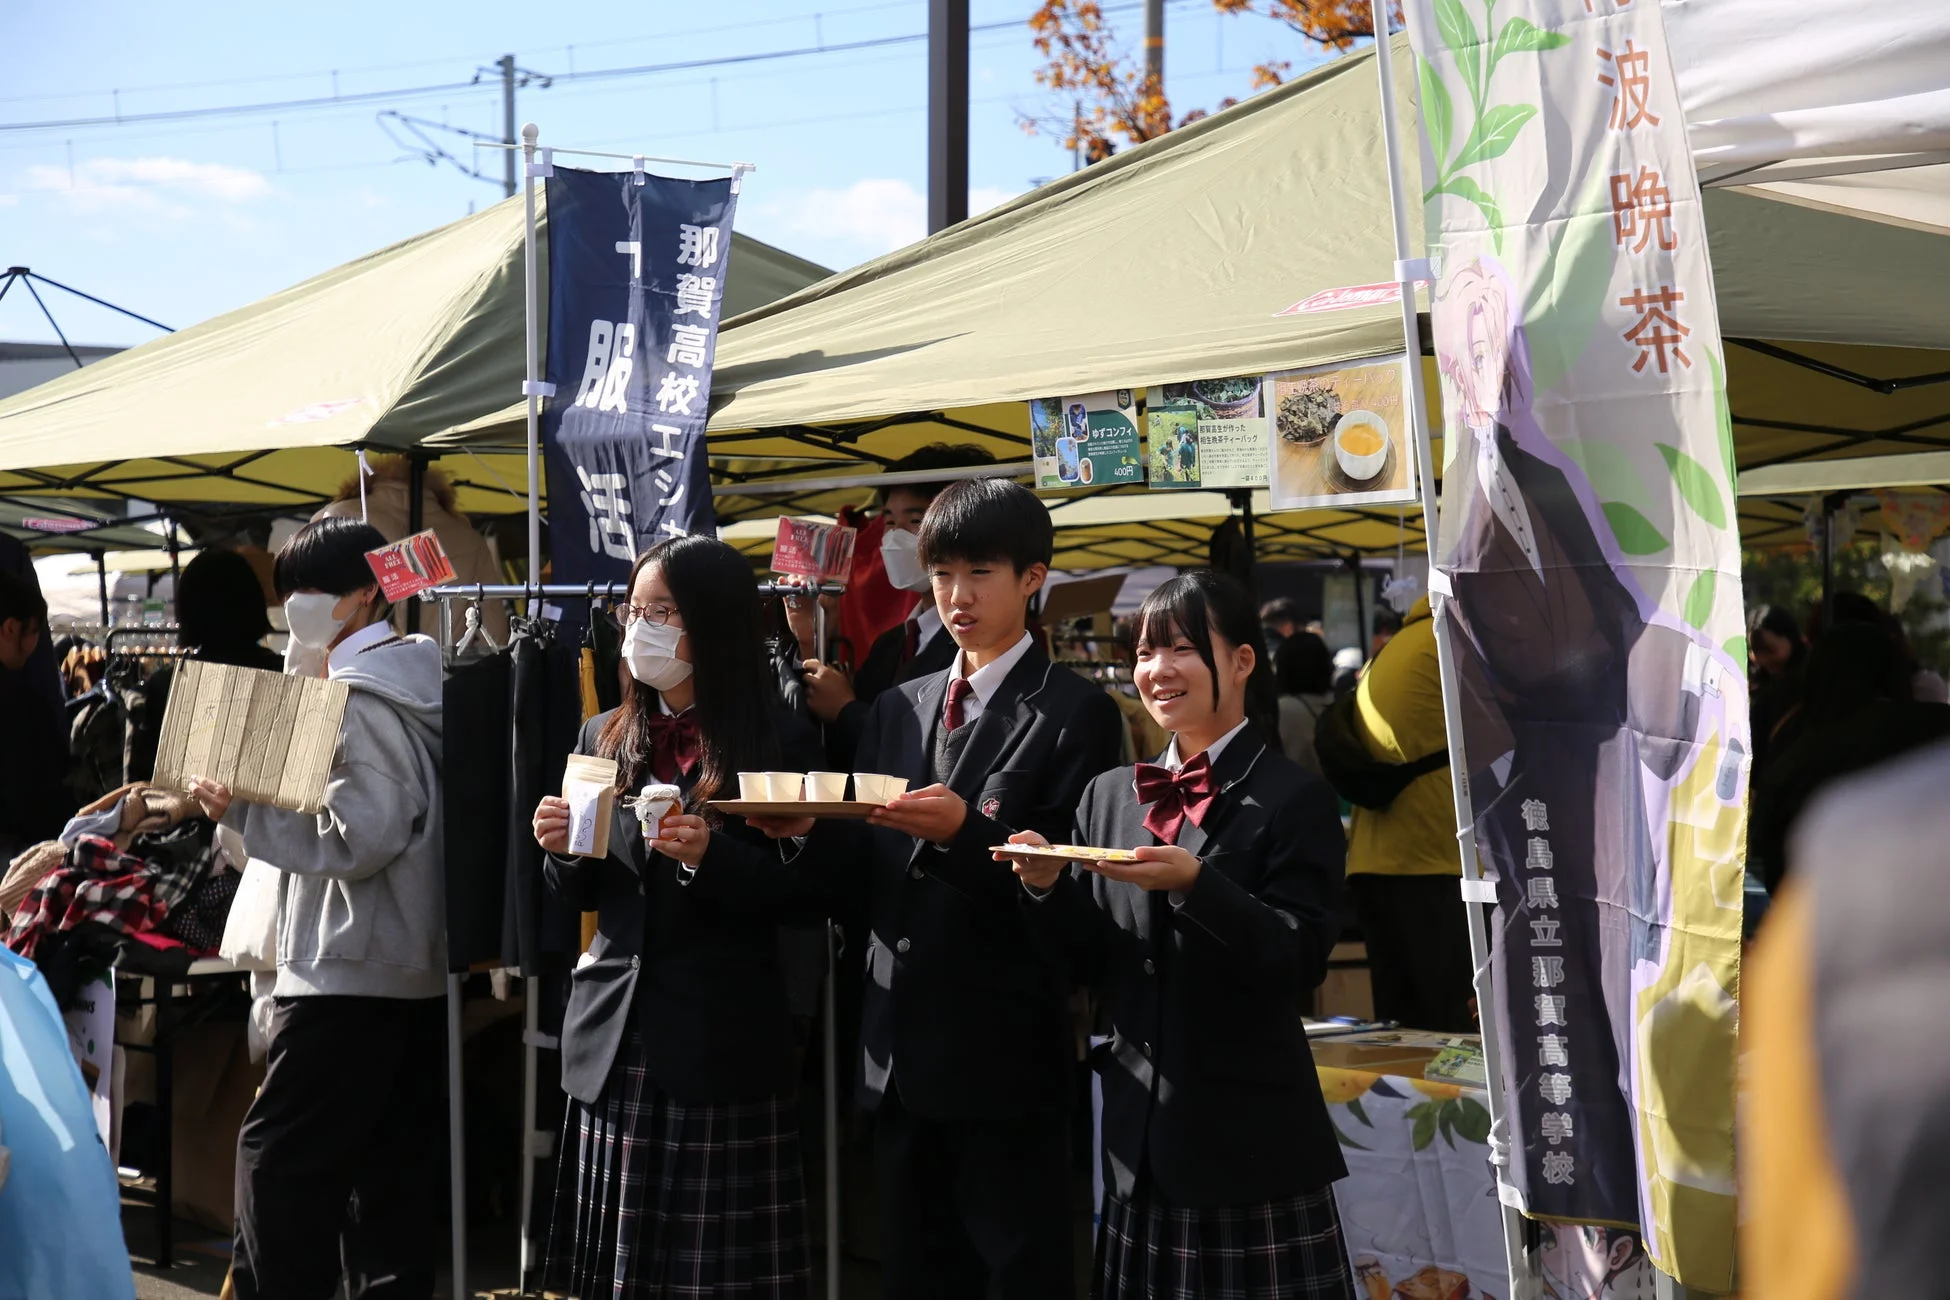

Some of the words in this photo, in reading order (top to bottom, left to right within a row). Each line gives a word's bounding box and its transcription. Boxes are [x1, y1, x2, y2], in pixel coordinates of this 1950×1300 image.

[1583, 0, 1692, 374] 波晩茶
[1092, 426, 1133, 439] ゆずコンフィ
[1114, 465, 1134, 477] 400円
[1521, 799, 1575, 1185] 徳島県立那賀高等学校
